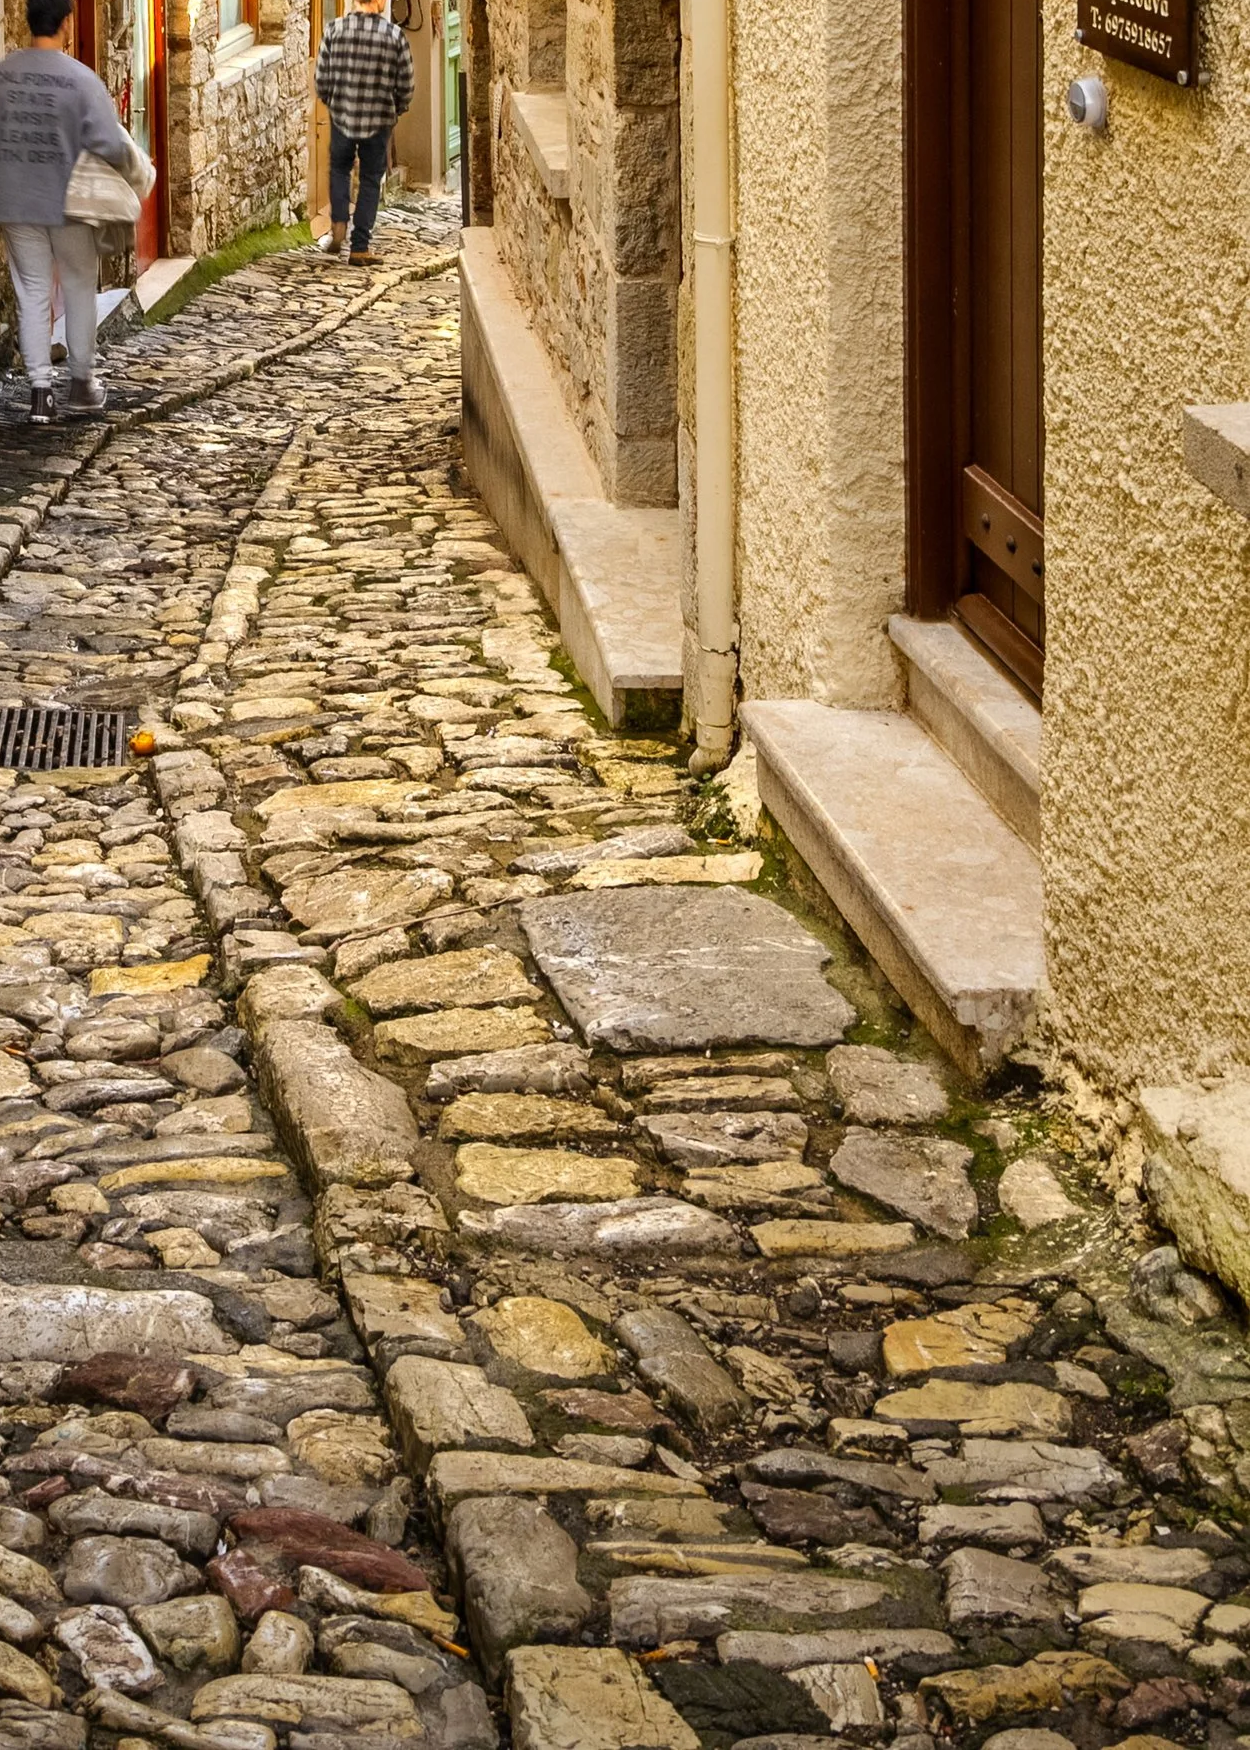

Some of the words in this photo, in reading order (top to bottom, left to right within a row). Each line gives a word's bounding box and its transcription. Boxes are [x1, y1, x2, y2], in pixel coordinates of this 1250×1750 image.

[1105, 12, 1173, 59] 6975918657
[6, 89, 57, 108] STATE
[0, 128, 60, 147] LEAGUE
